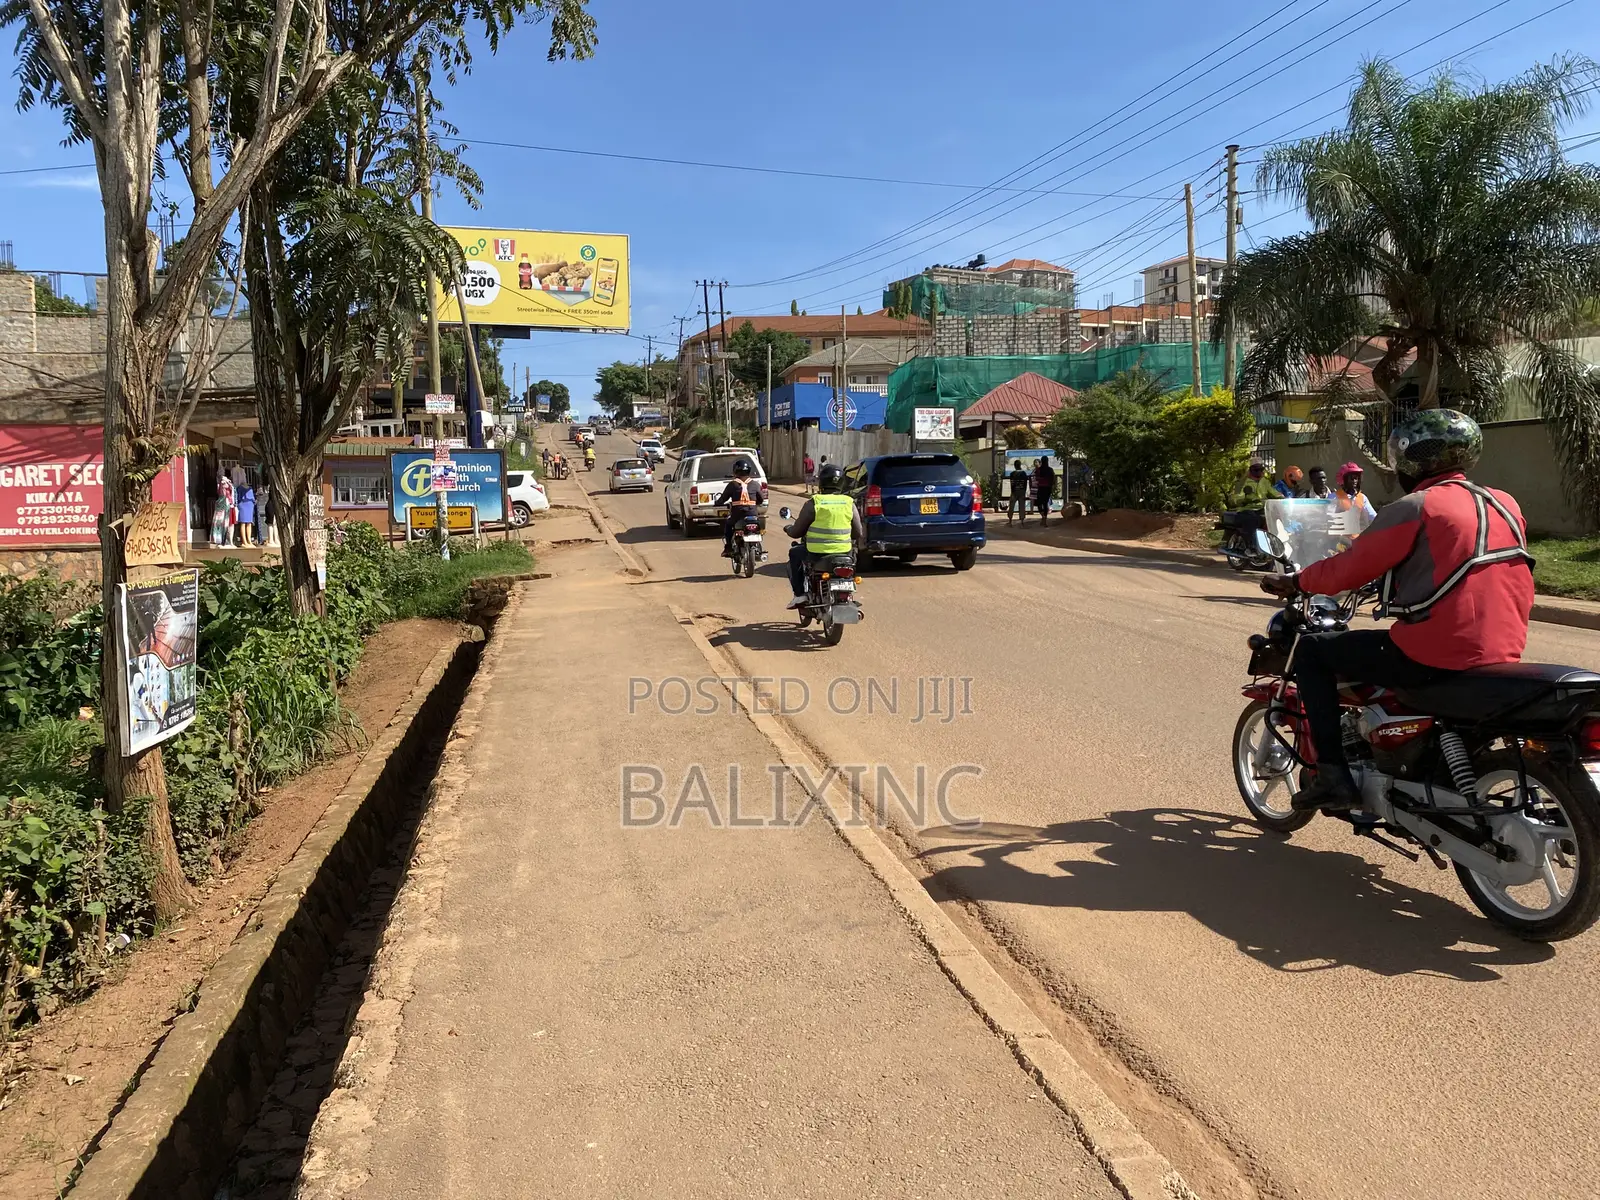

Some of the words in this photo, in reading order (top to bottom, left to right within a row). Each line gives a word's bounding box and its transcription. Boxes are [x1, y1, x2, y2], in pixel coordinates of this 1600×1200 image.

[465, 289, 485, 298] UGX
[455, 463, 491, 472] minion
[0, 464, 64, 487] GARET
[456, 473, 470, 482] ith
[458, 482, 481, 492] urch
[26, 491, 83, 503] KIKAAYA
[16, 505, 90, 515] 0773301487
[136, 516, 169, 532] HOUSES
[137, 579, 164, 589] Cleaners
[170, 573, 195, 585] Fumigators
